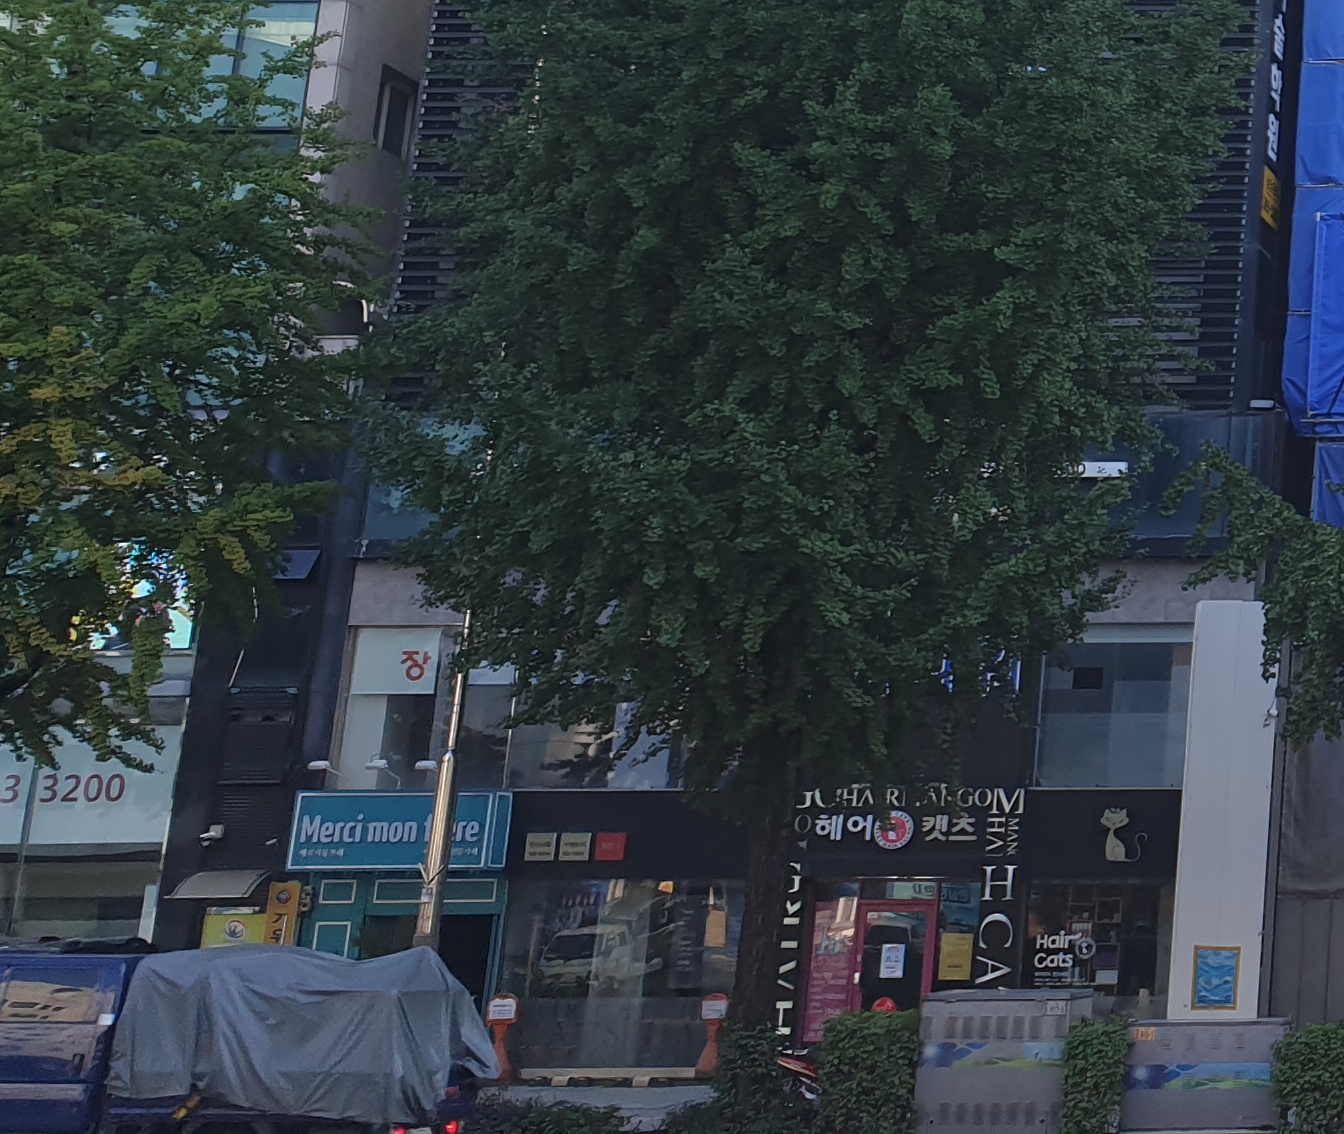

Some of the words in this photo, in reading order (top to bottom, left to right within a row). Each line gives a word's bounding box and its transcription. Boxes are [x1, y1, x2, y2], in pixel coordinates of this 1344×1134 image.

[39, 772, 126, 803] 3200
[299, 812, 362, 843] Merci
[367, 821, 418, 843] mon
[814, 814, 874, 841] 헤어
[1035, 930, 1082, 949] Hair
[1034, 952, 1073, 968] Cats
